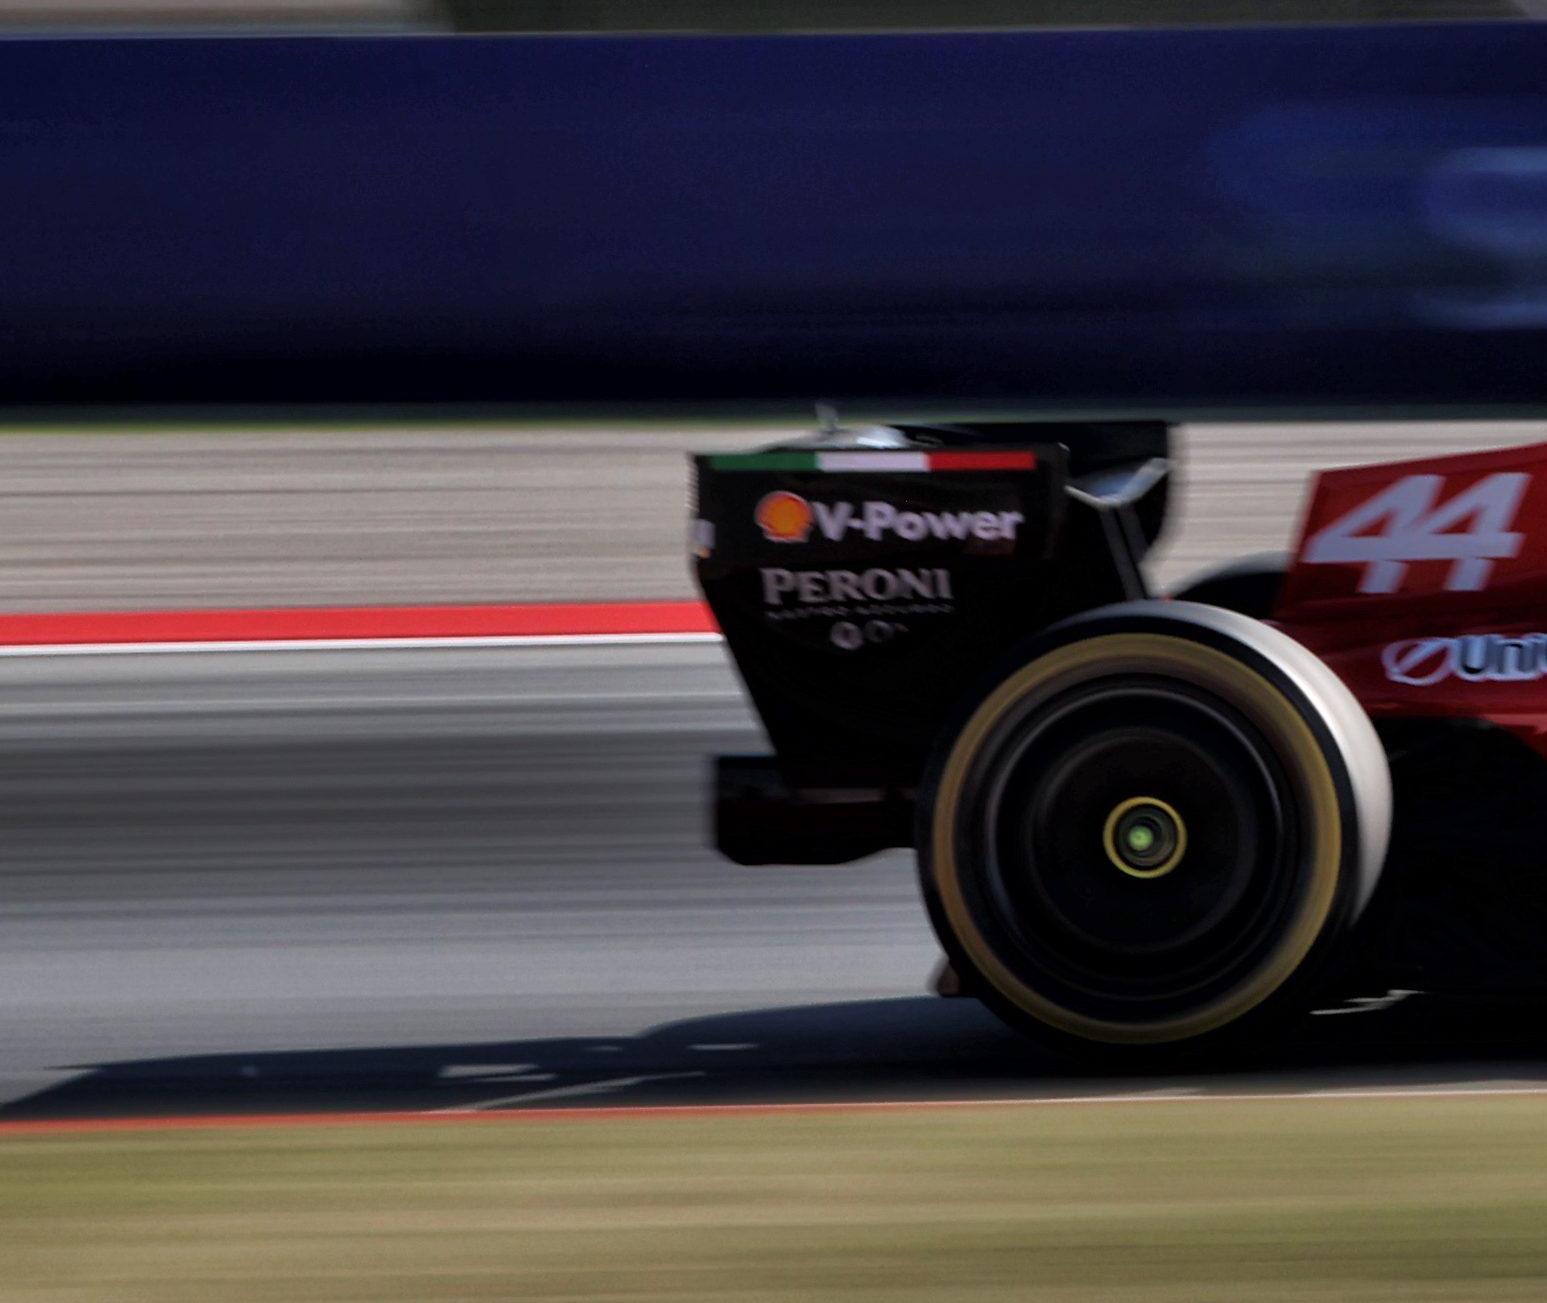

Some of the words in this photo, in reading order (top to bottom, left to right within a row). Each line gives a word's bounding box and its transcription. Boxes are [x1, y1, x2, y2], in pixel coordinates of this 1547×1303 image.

[813, 500, 1025, 542] V-Power
[1301, 472, 1533, 593] 44
[759, 567, 954, 606] PERONI
